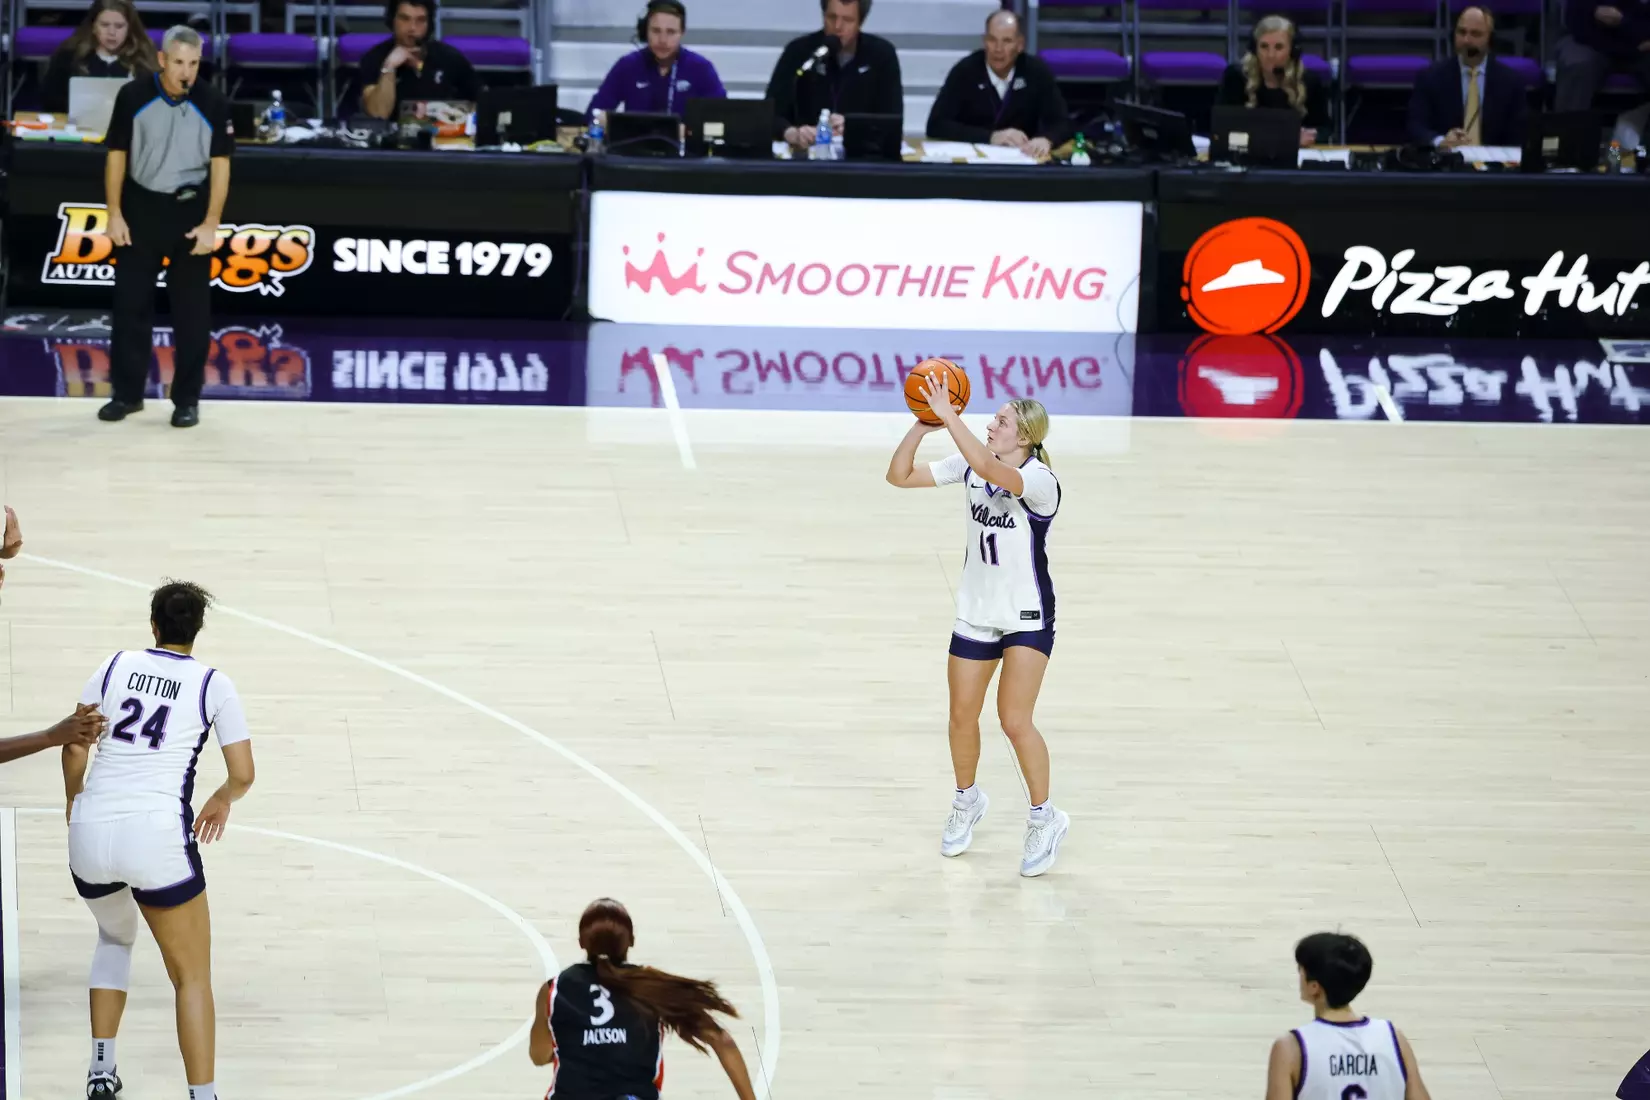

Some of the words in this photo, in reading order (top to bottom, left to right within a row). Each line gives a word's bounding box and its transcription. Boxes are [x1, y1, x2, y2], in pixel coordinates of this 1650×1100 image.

[333, 238, 449, 274] SINCE
[455, 241, 553, 277] 1979
[718, 251, 973, 297] SMOOTHIE
[1322, 246, 1514, 318] Pizza
[1521, 251, 1650, 316] Hut
[980, 531, 999, 566] 11
[127, 672, 181, 700] COTTON
[111, 697, 171, 750] 24
[589, 983, 615, 1026] 3
[582, 1028, 627, 1046] JACKSON
[1329, 1053, 1378, 1077] GARCIA
